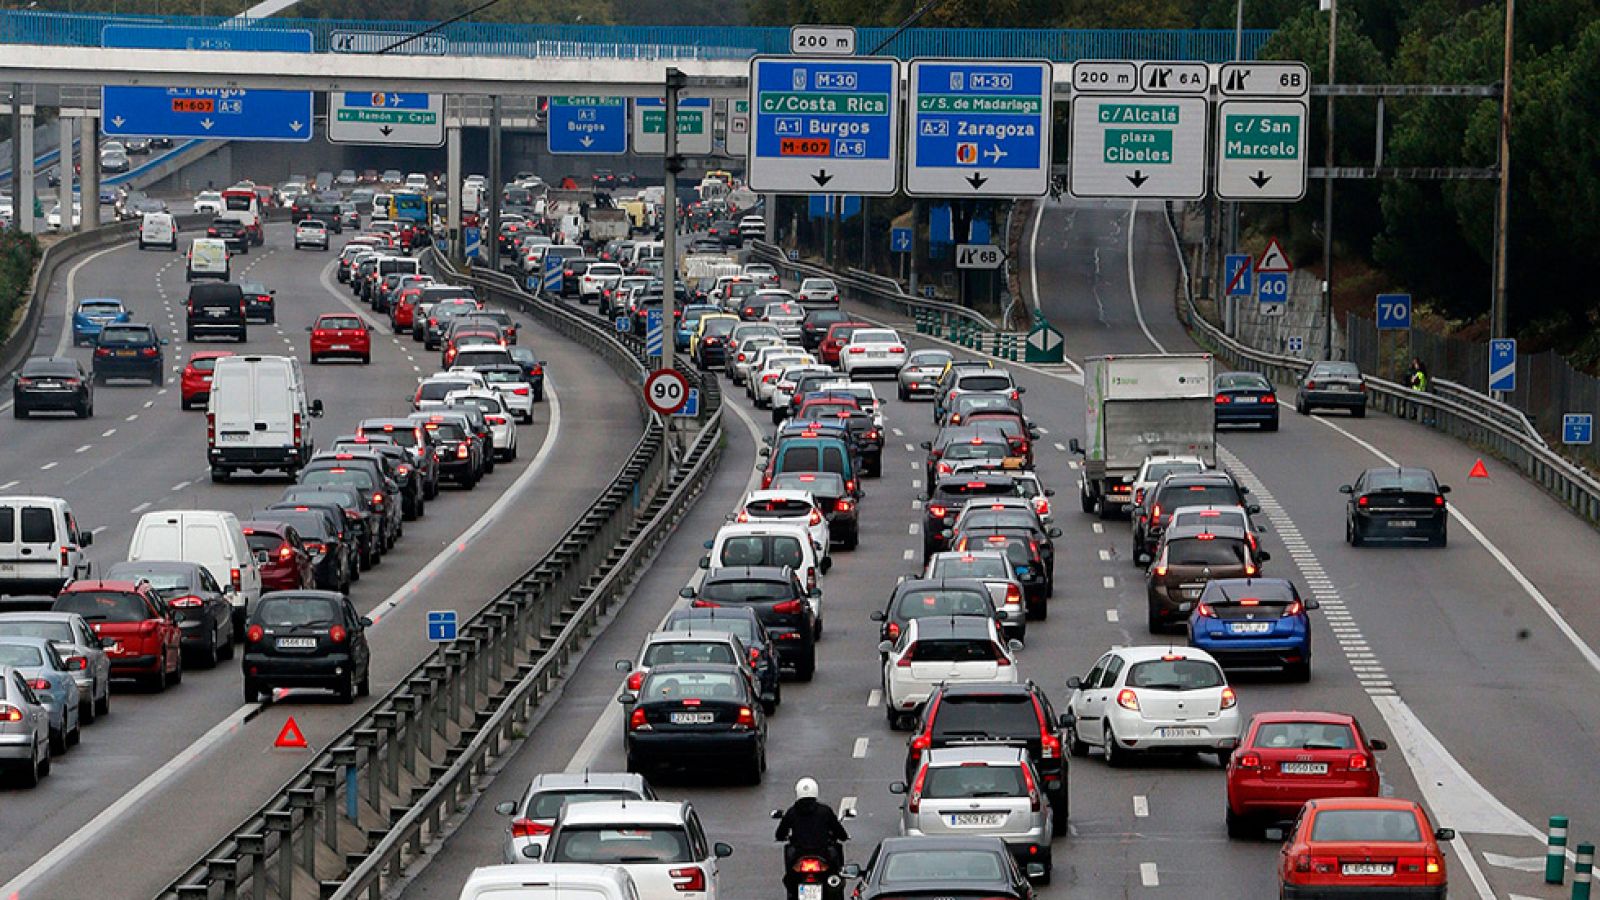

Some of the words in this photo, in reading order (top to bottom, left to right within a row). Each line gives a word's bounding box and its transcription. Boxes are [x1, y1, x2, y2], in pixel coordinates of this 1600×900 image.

[798, 36, 827, 47] 200
[836, 38, 848, 47] m
[818, 74, 855, 86] M-30
[972, 76, 1010, 87] M-30
[1080, 72, 1109, 82] 200
[1118, 74, 1129, 83] m
[1180, 73, 1201, 84] 6A
[1280, 73, 1301, 87] 6B
[174, 101, 211, 110] M-607
[847, 98, 884, 111] Rica
[953, 99, 969, 109] de
[973, 99, 1038, 113] Madariaga
[359, 111, 391, 119] Ramón
[397, 114, 403, 122] y
[567, 121, 605, 132] Burgos
[778, 122, 799, 132] A-1
[809, 119, 870, 137] Burgos
[923, 124, 947, 134] A-2
[957, 121, 1035, 139] Zaragoza
[1260, 118, 1291, 133] San
[1121, 132, 1155, 144] plaza
[782, 142, 828, 153] M-607
[838, 143, 863, 154] A-6
[1106, 146, 1170, 161] Cibeles
[1227, 141, 1295, 155] Marcelo
[980, 251, 997, 264] 6B
[1261, 280, 1286, 295] 40
[1380, 303, 1407, 320] 70
[654, 383, 681, 399] 90
